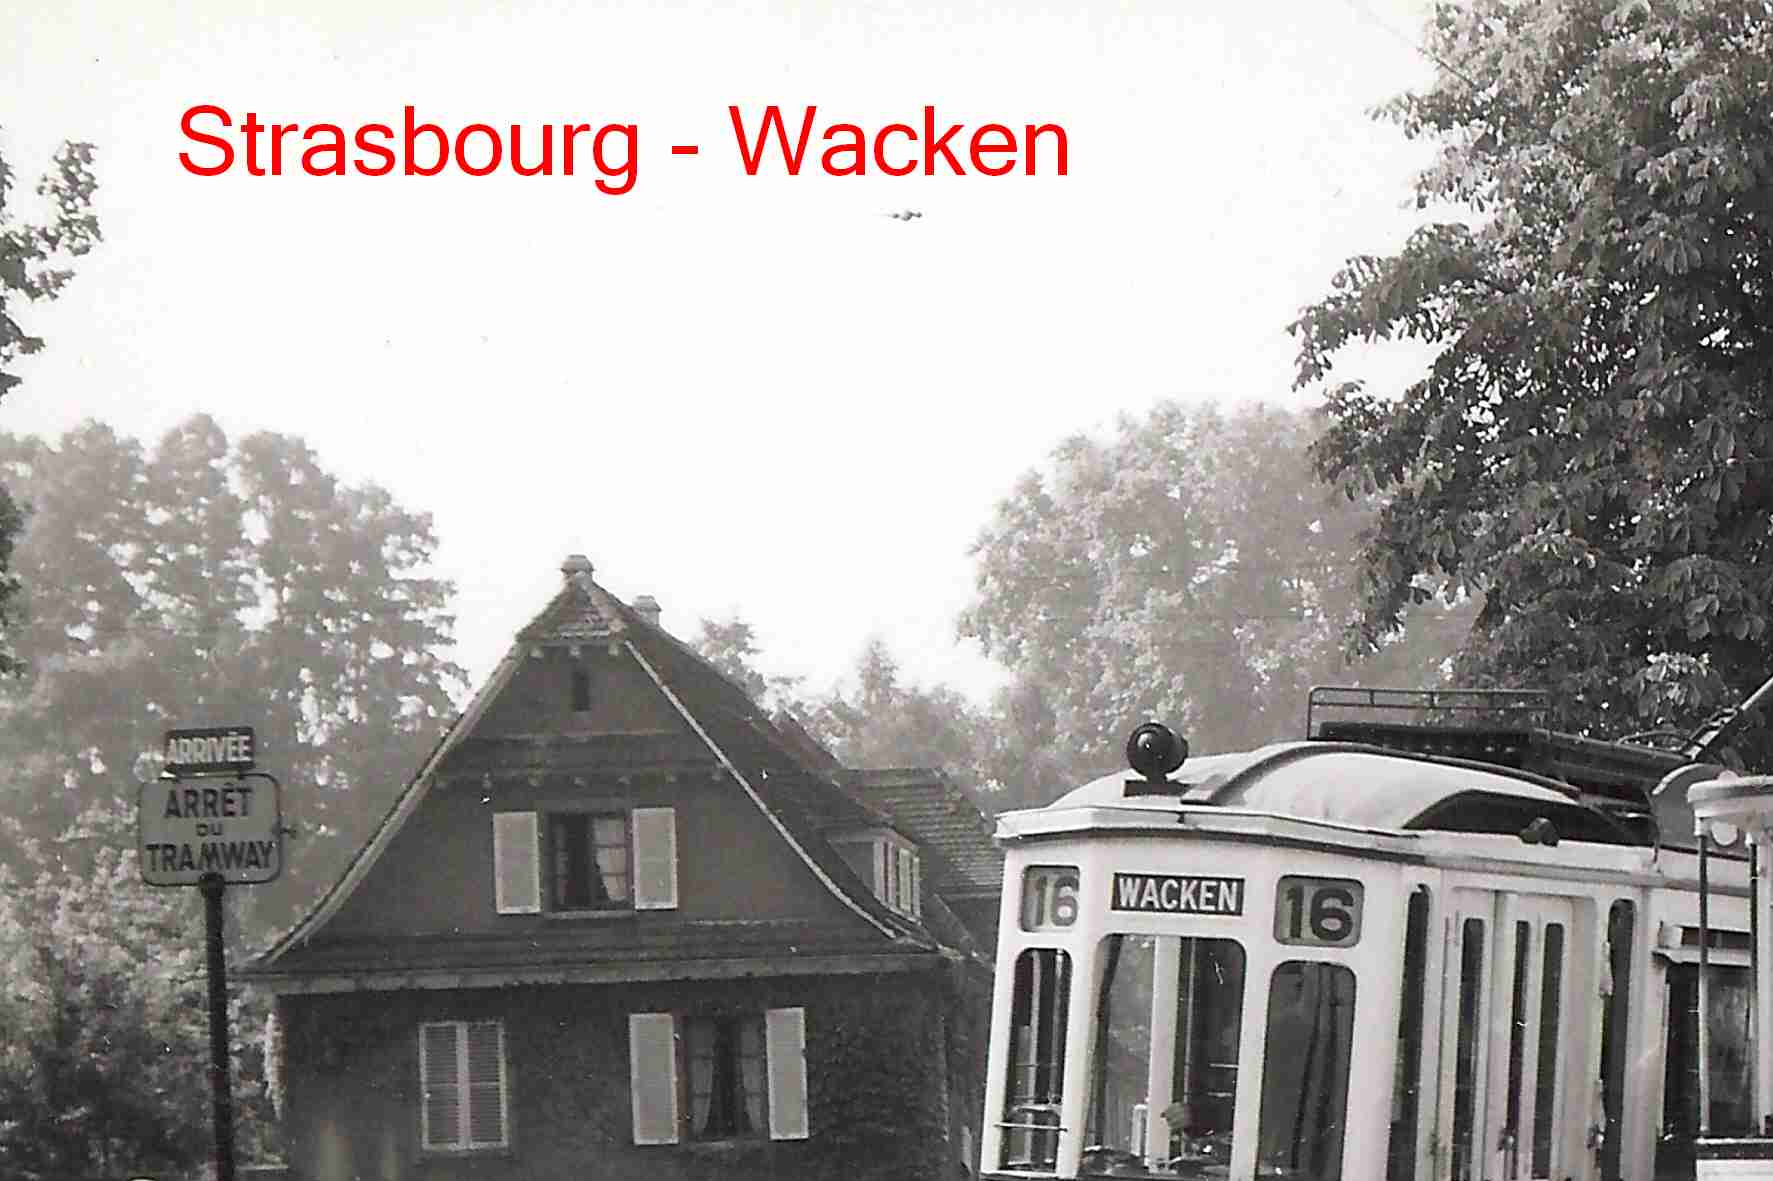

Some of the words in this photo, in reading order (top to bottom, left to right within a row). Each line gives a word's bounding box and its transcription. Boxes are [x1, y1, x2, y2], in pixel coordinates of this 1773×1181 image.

[167, 732, 251, 764] ARRIVÉE
[164, 783, 253, 818] ARRÊT
[196, 823, 223, 837] DU
[146, 841, 274, 872] TRAMWAY
[1027, 874, 1080, 928] 16
[1119, 877, 1238, 913] WACKEN
[1284, 886, 1355, 942] 16
